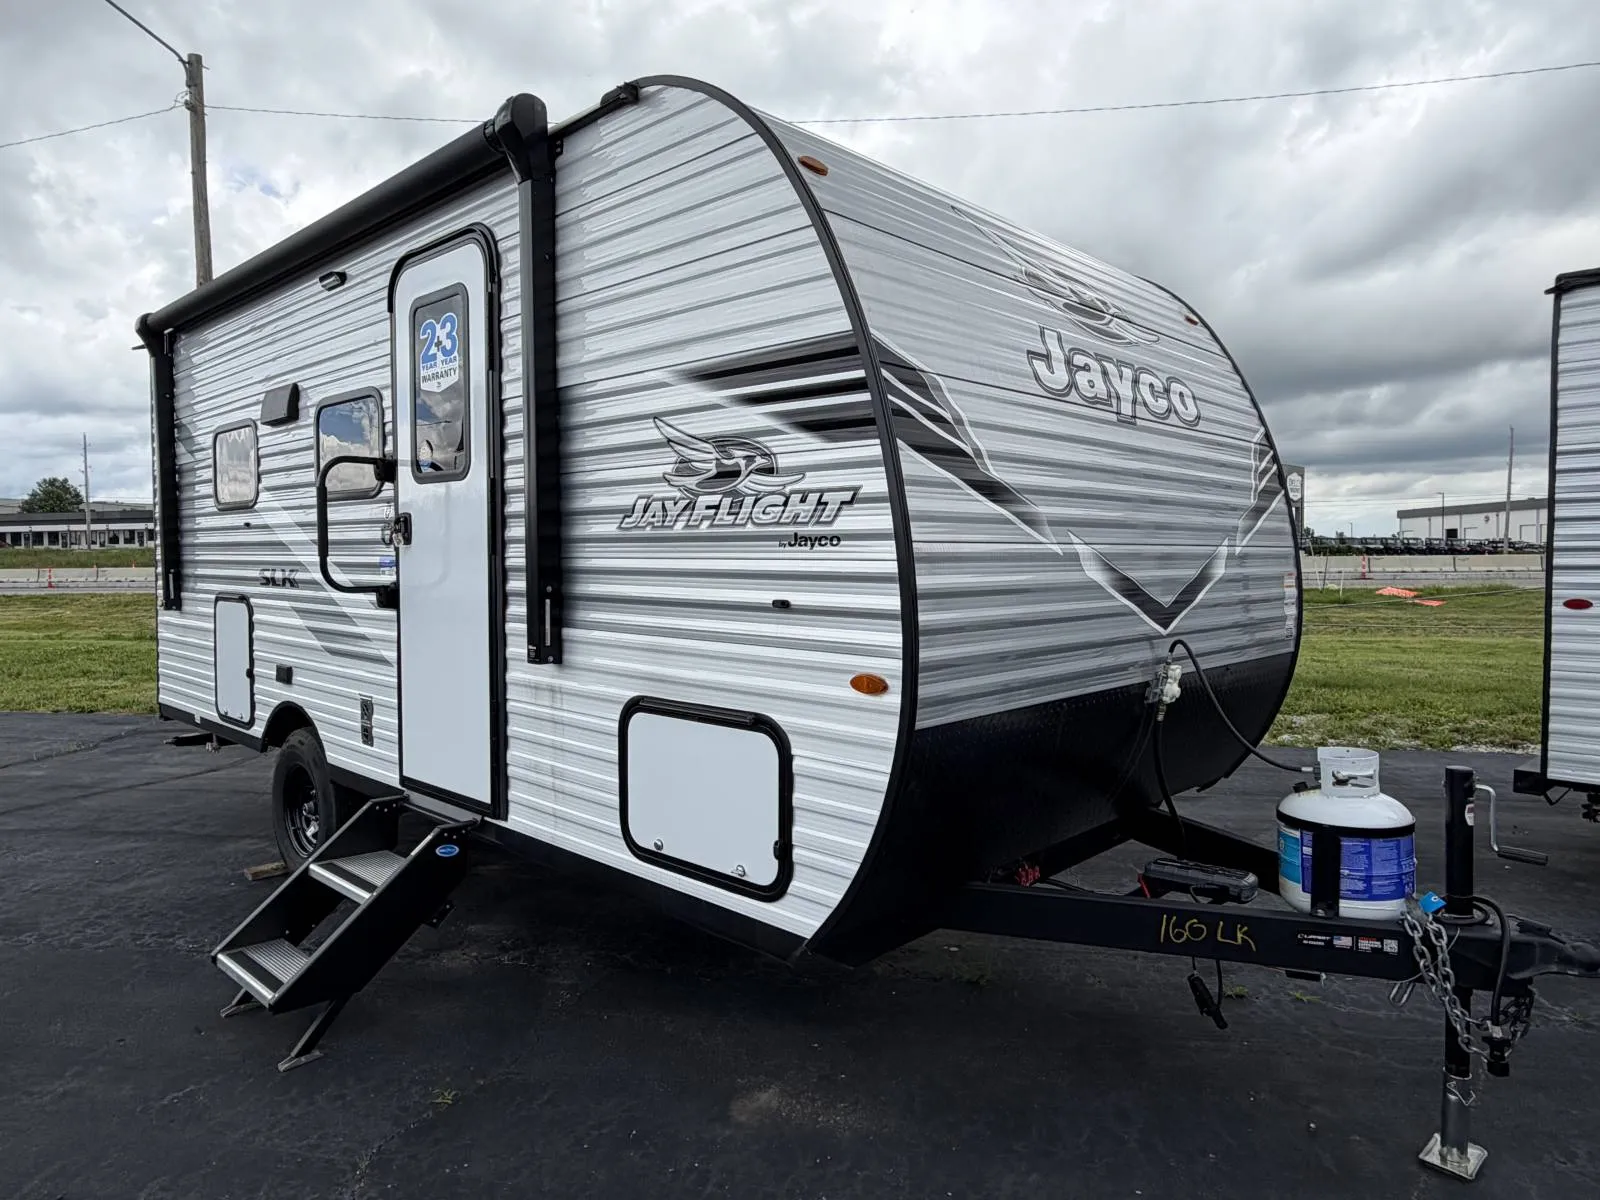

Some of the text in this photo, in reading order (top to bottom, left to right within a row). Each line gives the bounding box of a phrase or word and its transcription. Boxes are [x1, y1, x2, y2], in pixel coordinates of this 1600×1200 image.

[421, 356, 457, 371] YEAR YEAR
[421, 367, 457, 384] WARRANTY
[1026, 325, 1201, 427] Jayco
[788, 532, 842, 551] Jayco
[259, 568, 300, 589] SLK
[1160, 914, 1257, 952] 160 LK
